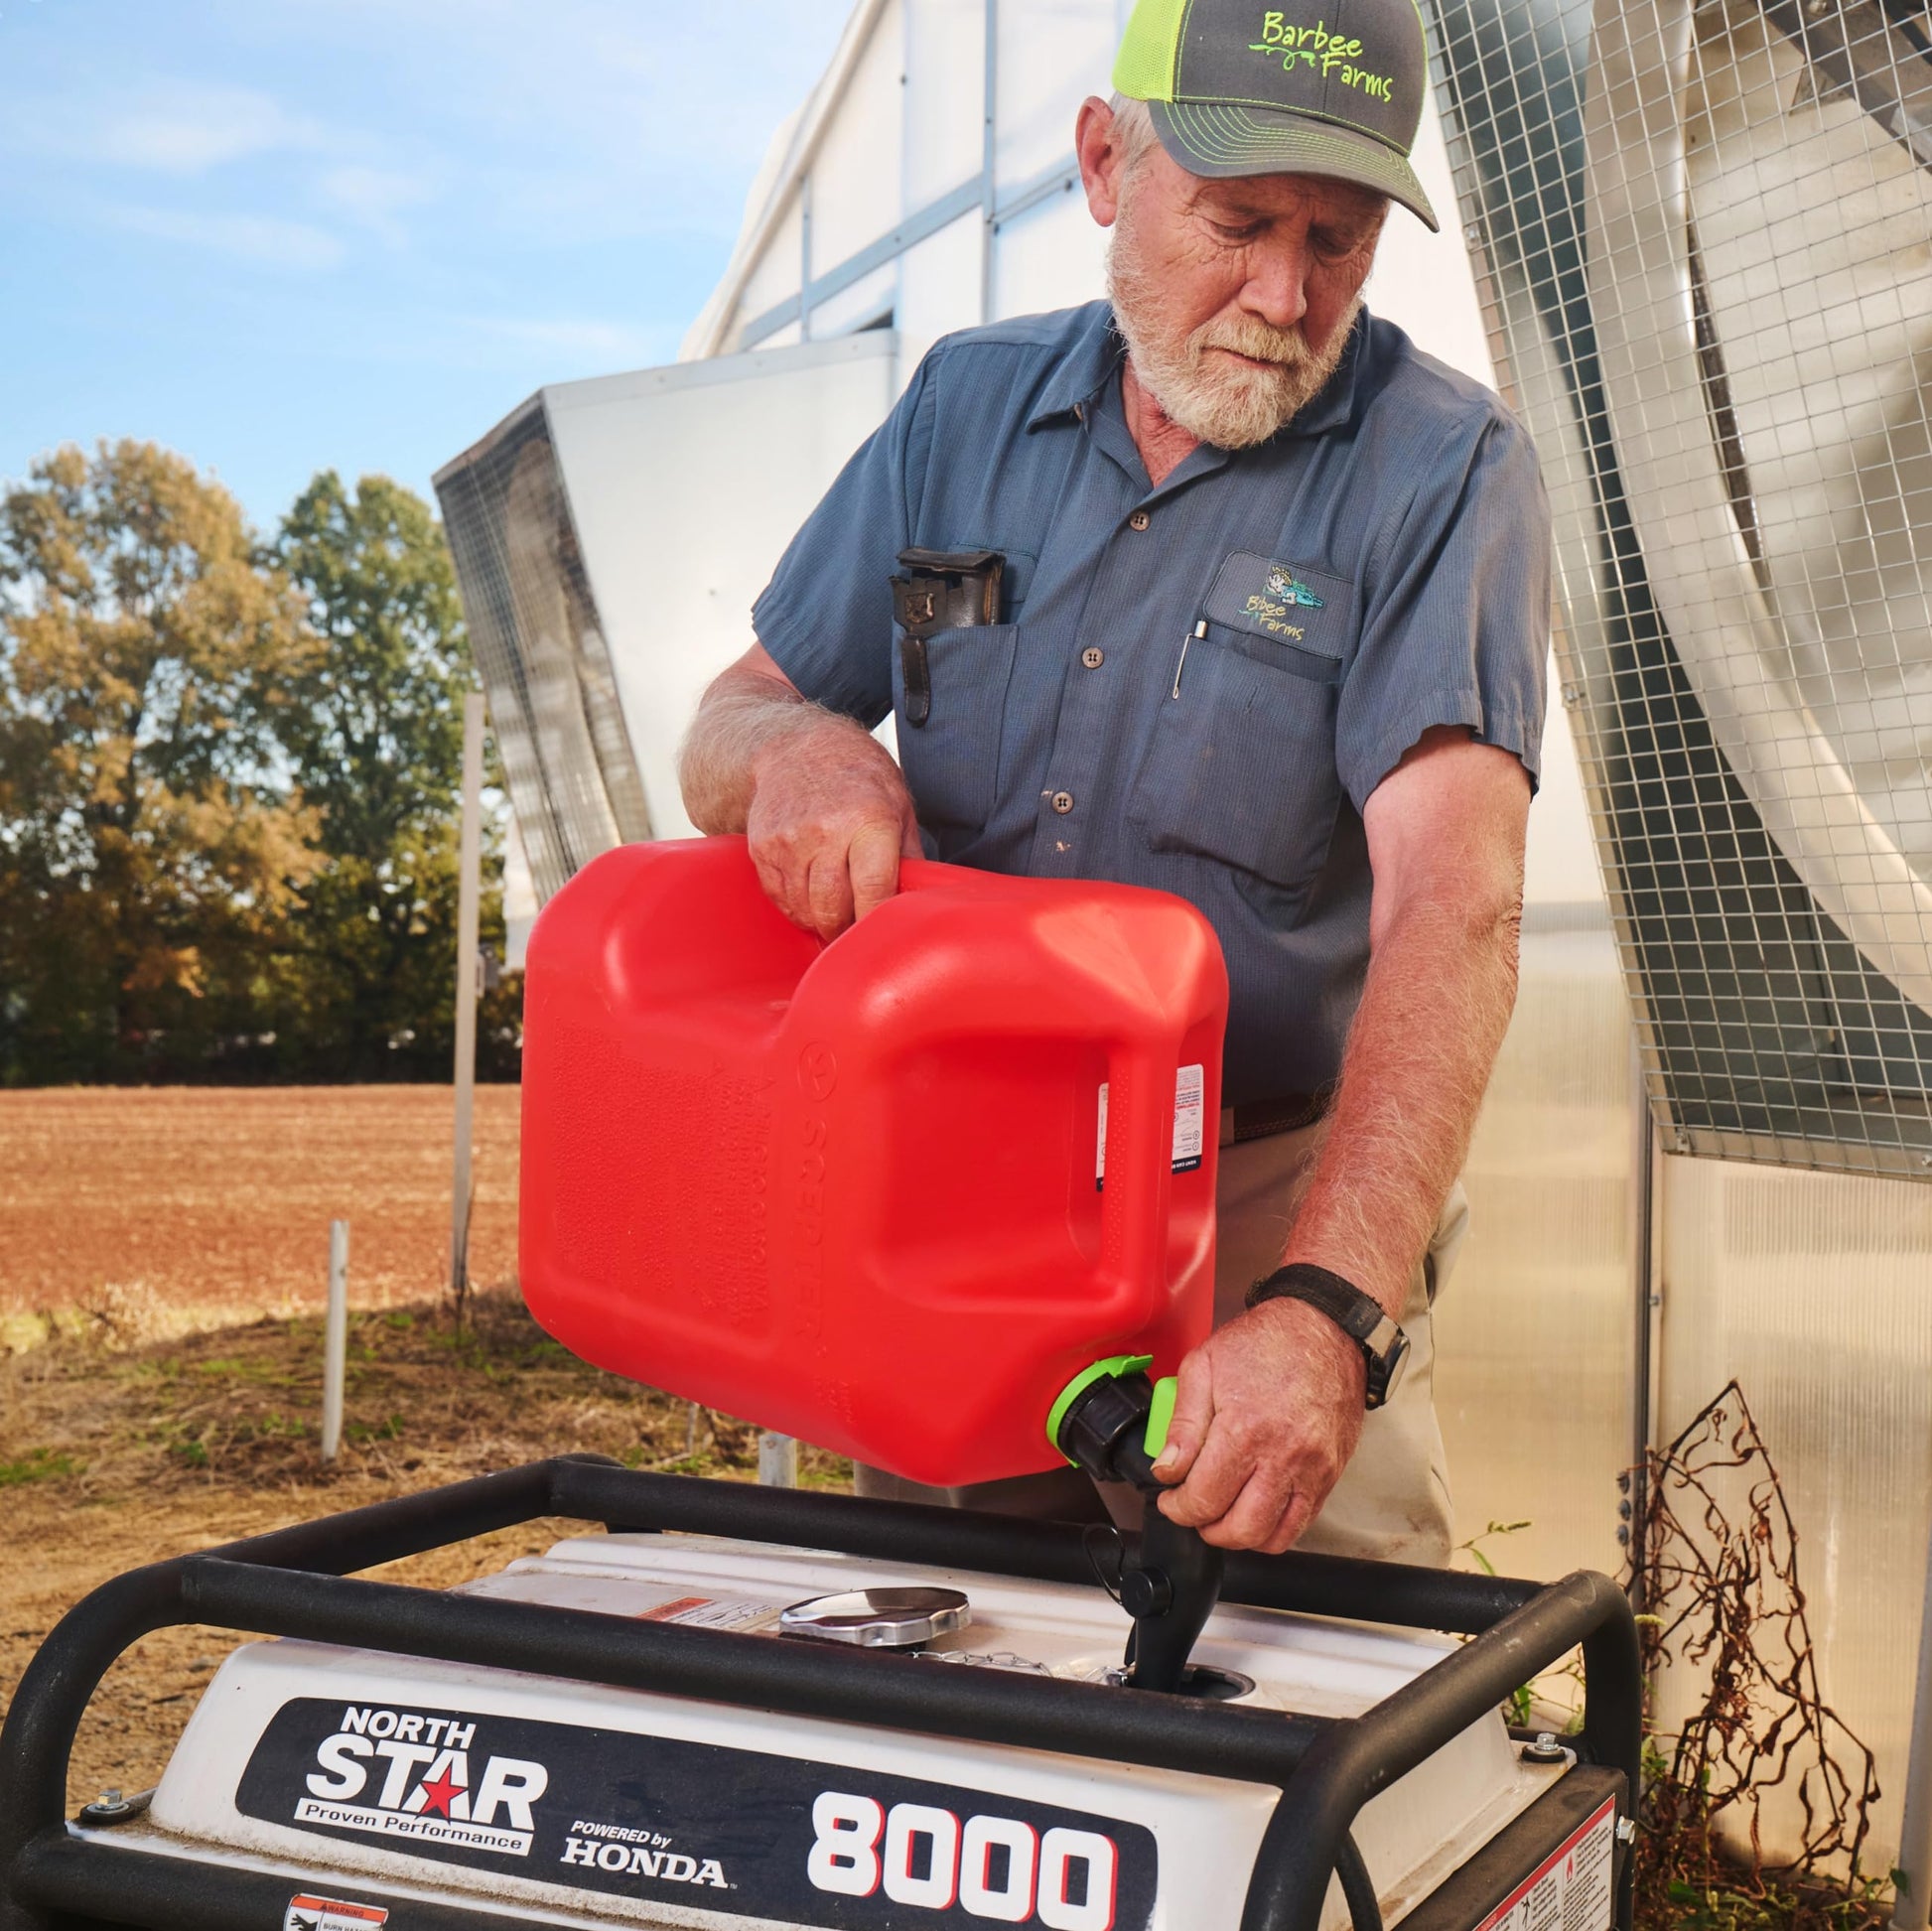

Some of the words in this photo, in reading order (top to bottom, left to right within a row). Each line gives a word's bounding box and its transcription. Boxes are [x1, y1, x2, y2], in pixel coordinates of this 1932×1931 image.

[1263, 11, 1363, 57] Barbee
[1319, 51, 1393, 102] Farms
[1259, 612, 1306, 641] Farms
[795, 1116, 828, 1339] SCEPTER
[340, 1706, 477, 1749] NORTH
[306, 1732, 548, 1831] STAR
[306, 1804, 376, 1827] Proven
[384, 1816, 522, 1850] Performance
[571, 1820, 650, 1844] POWERED
[650, 1833, 672, 1850] by
[560, 1837, 729, 1889] HONDA
[807, 1790, 1119, 1931] 8000
[328, 1903, 364, 1917] WARNING
